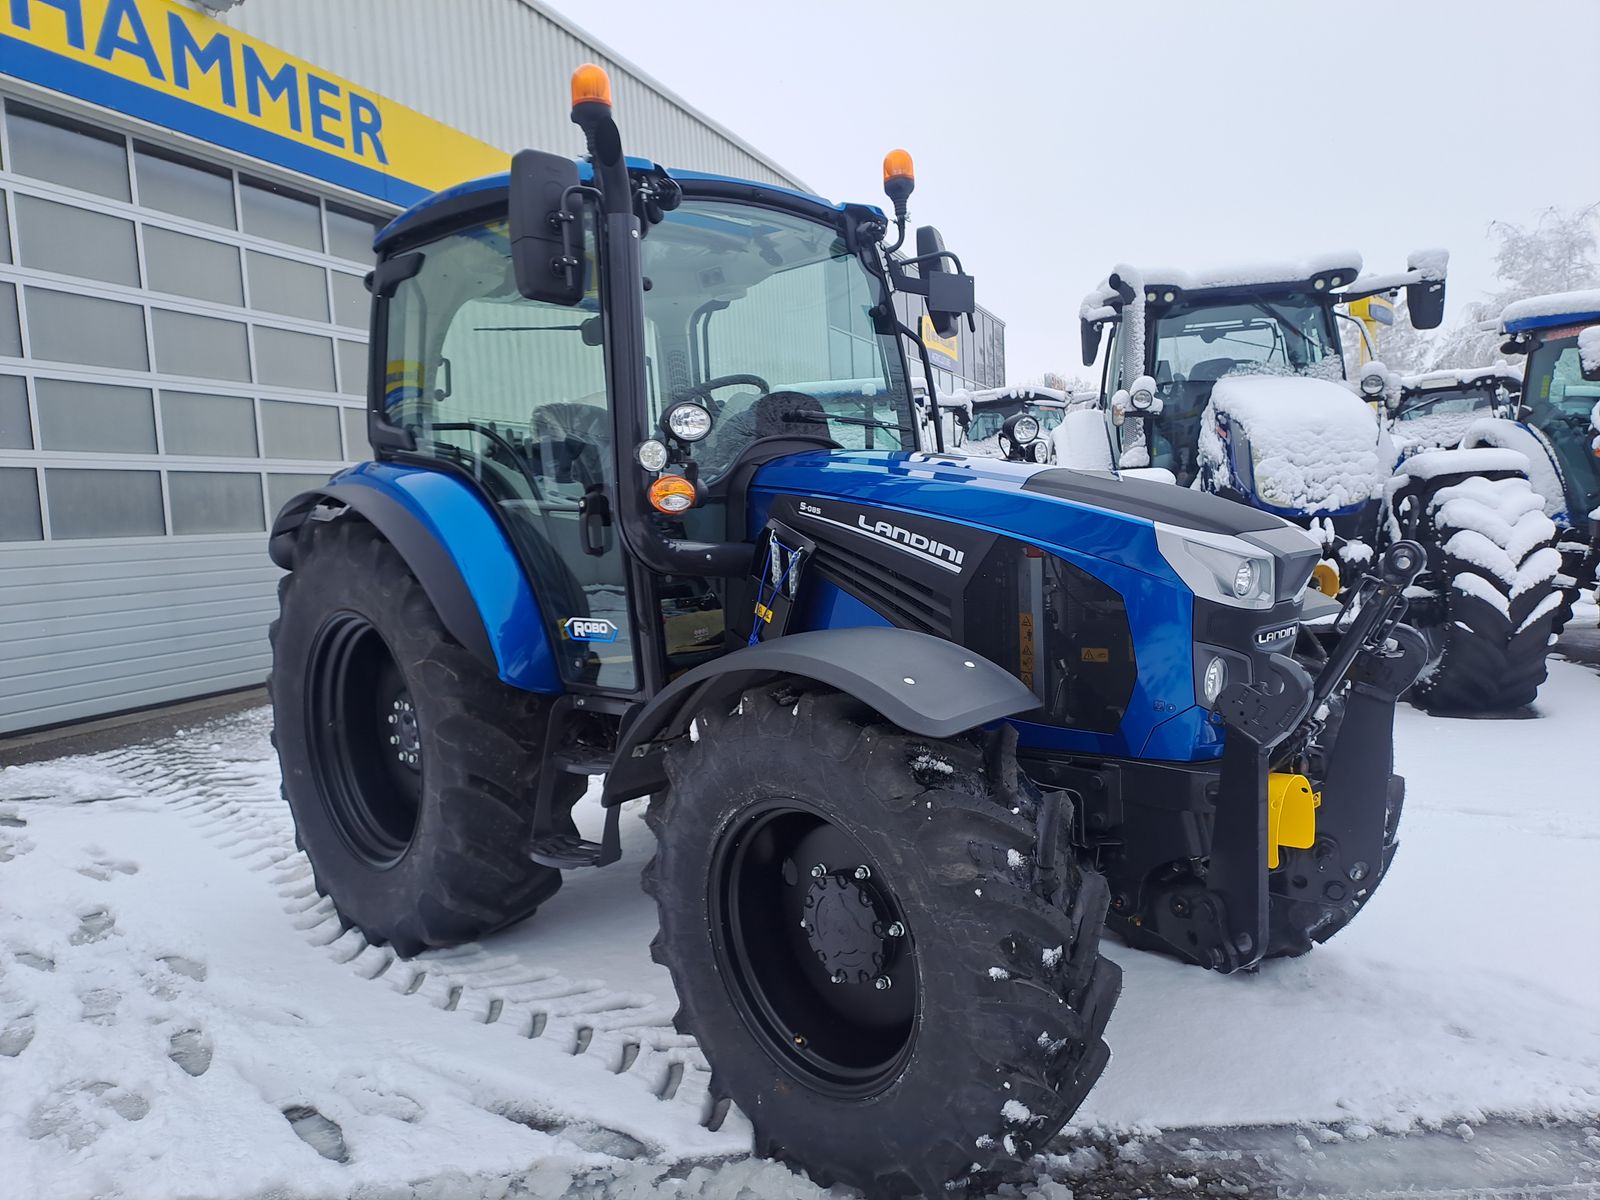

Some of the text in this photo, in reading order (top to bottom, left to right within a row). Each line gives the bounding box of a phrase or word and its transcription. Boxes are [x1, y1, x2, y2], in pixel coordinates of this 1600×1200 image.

[858, 515, 965, 565] LANDINI
[573, 621, 608, 637] ROBO
[1258, 625, 1296, 644] LANDINI
